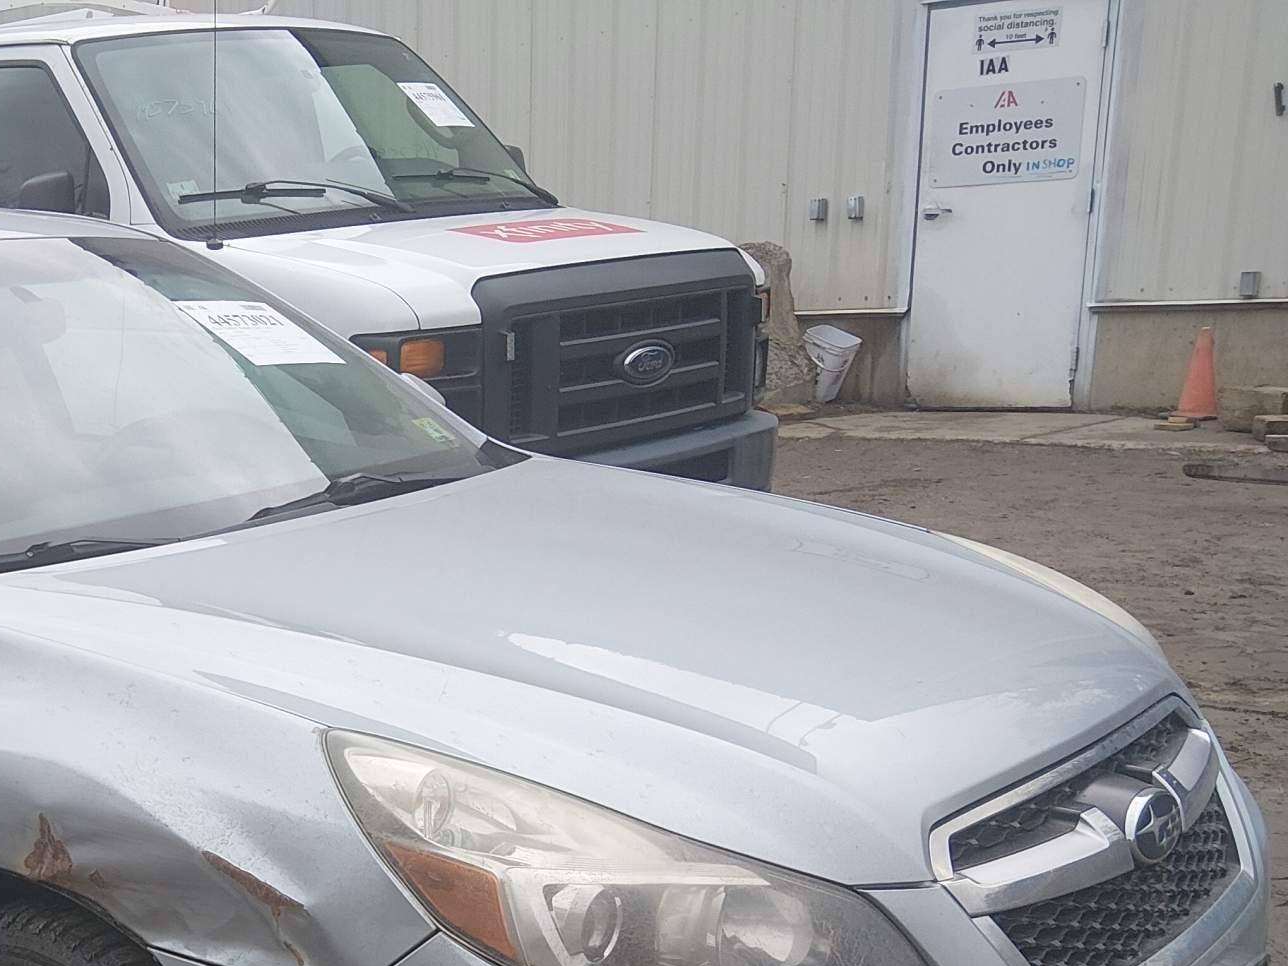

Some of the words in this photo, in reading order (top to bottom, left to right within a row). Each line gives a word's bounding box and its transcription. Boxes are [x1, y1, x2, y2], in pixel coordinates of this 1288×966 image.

[1024, 9, 1059, 18] respecting
[978, 22, 1005, 32] social
[1007, 18, 1057, 30] distancing.
[979, 57, 1010, 76] IAA
[958, 118, 1054, 136] Employees
[951, 138, 1058, 156] Contractors
[982, 159, 1022, 175] Only
[492, 221, 613, 239] xfinity
